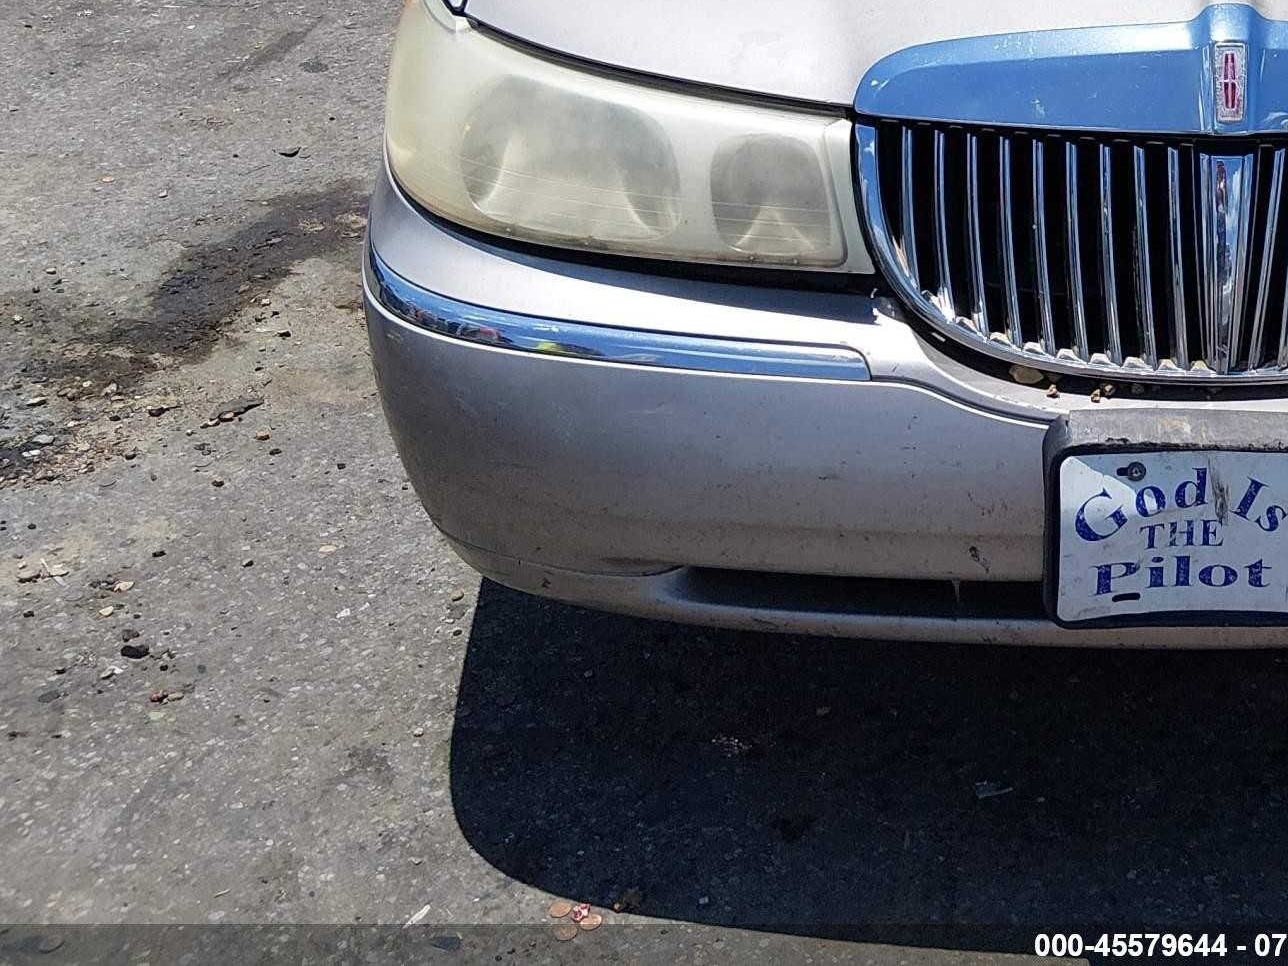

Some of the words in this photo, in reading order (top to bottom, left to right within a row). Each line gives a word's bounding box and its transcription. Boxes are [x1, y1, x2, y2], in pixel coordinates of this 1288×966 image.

[1075, 467, 1208, 542] God
[1231, 476, 1288, 532] Is
[1140, 519, 1223, 549] THE
[1091, 555, 1273, 596] Pilot
